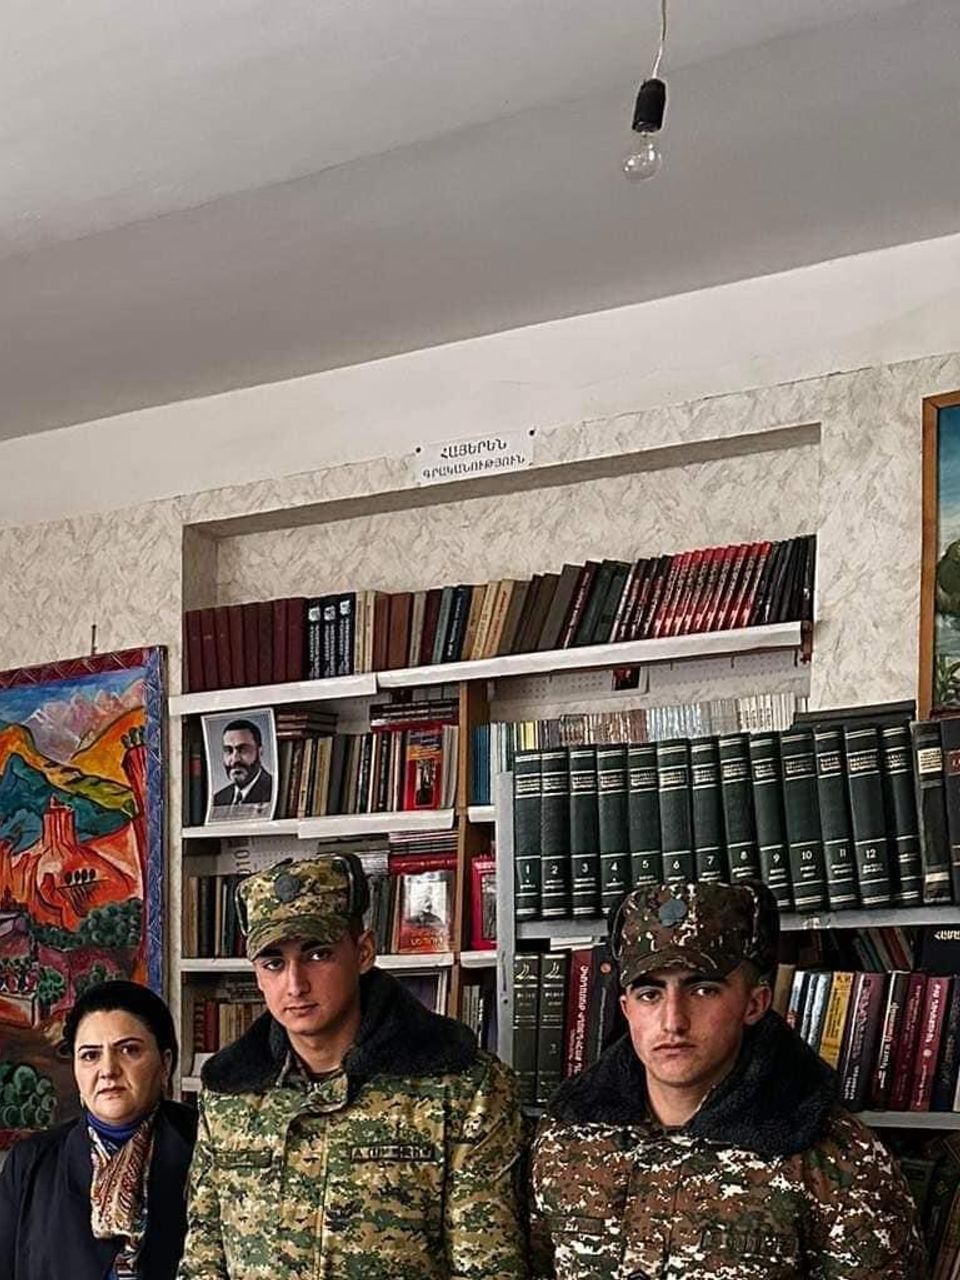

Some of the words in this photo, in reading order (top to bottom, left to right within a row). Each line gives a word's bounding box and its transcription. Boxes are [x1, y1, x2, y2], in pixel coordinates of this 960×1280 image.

[440, 438, 507, 459] ՀԱՅԵՐԵՆ
[422, 454, 525, 479] ԳՐԱԿԱՆՈՒԹՅՈՒՆ
[773, 853, 780, 863] 9
[801, 850, 813, 861] 10
[839, 848, 847, 858] 11
[866, 848, 877, 860] 12
[642, 860, 649, 869] 5
[673, 860, 680, 870] 6
[706, 856, 714, 865] 7
[525, 864, 530, 874] 1
[551, 865, 558, 874] 2
[582, 863, 589, 873] 3
[611, 862, 618, 871] 4
